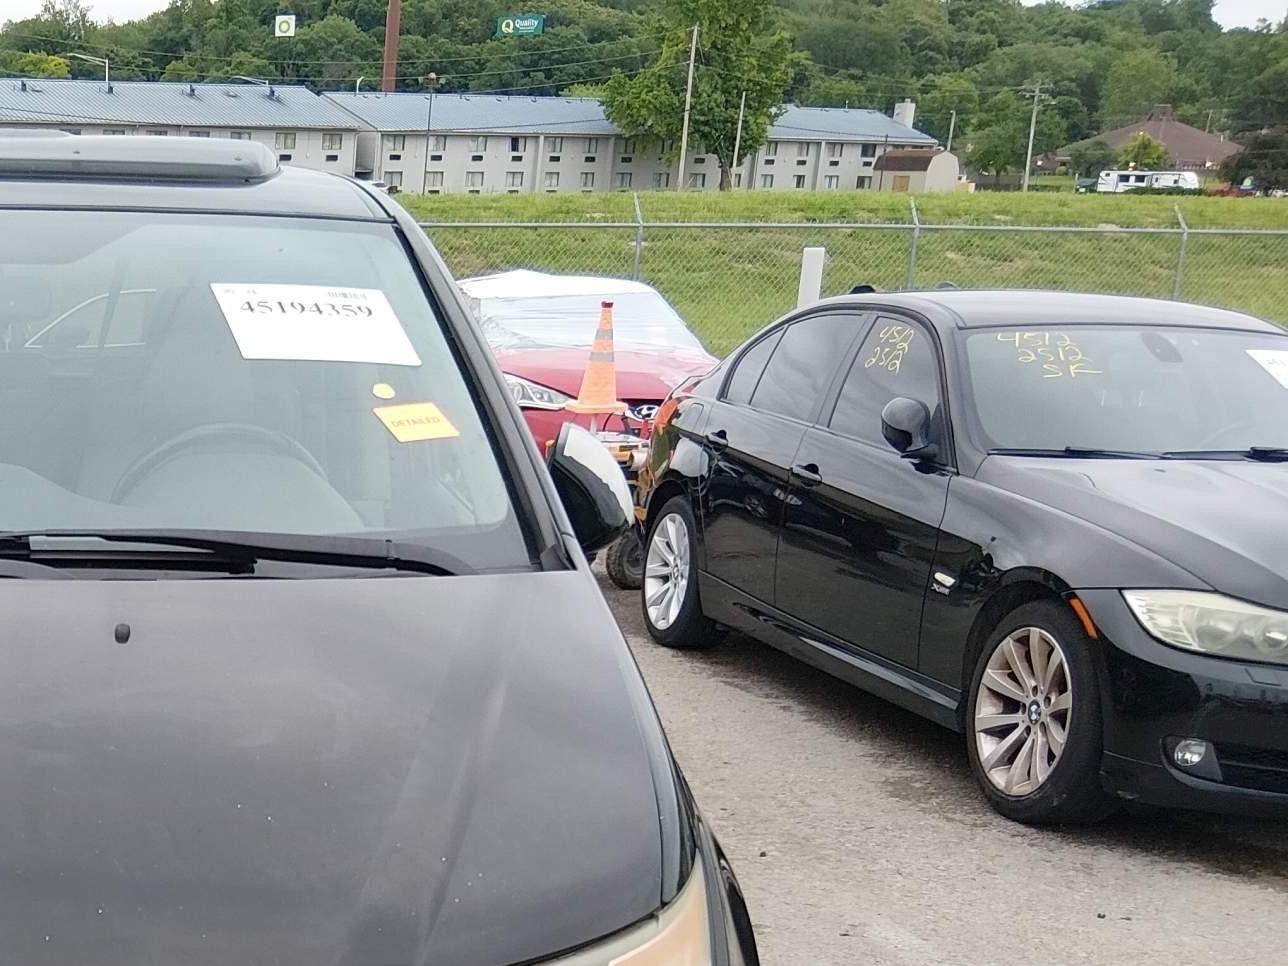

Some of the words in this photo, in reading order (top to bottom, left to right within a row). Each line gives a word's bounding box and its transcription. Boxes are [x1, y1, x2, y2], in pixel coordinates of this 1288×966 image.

[515, 18, 539, 28] Quality
[240, 300, 373, 318] 45194359
[997, 331, 1078, 347] 4512
[1018, 346, 1090, 362] 2512
